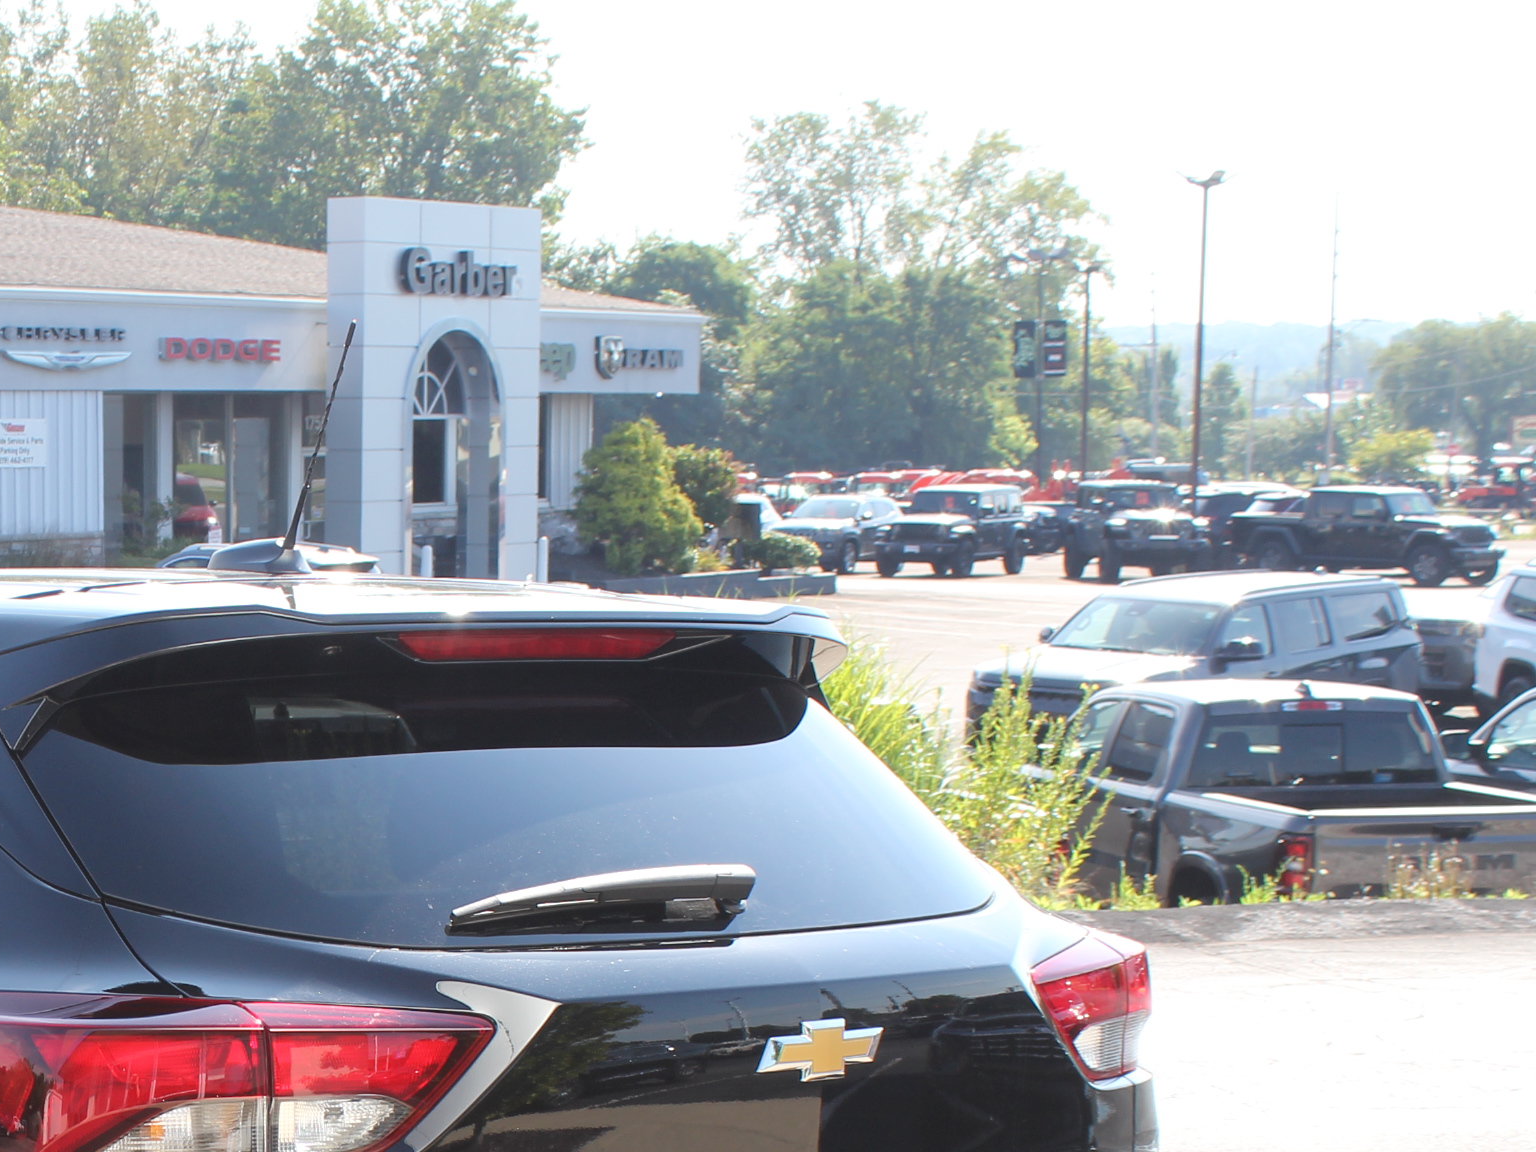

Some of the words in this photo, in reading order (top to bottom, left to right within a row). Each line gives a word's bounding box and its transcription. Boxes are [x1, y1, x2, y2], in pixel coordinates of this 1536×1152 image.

[401, 247, 517, 297] Garber
[0, 325, 126, 342] CHRYSLER
[161, 337, 282, 363] DODGE
[540, 342, 576, 381] eep
[625, 348, 684, 369] RAM
